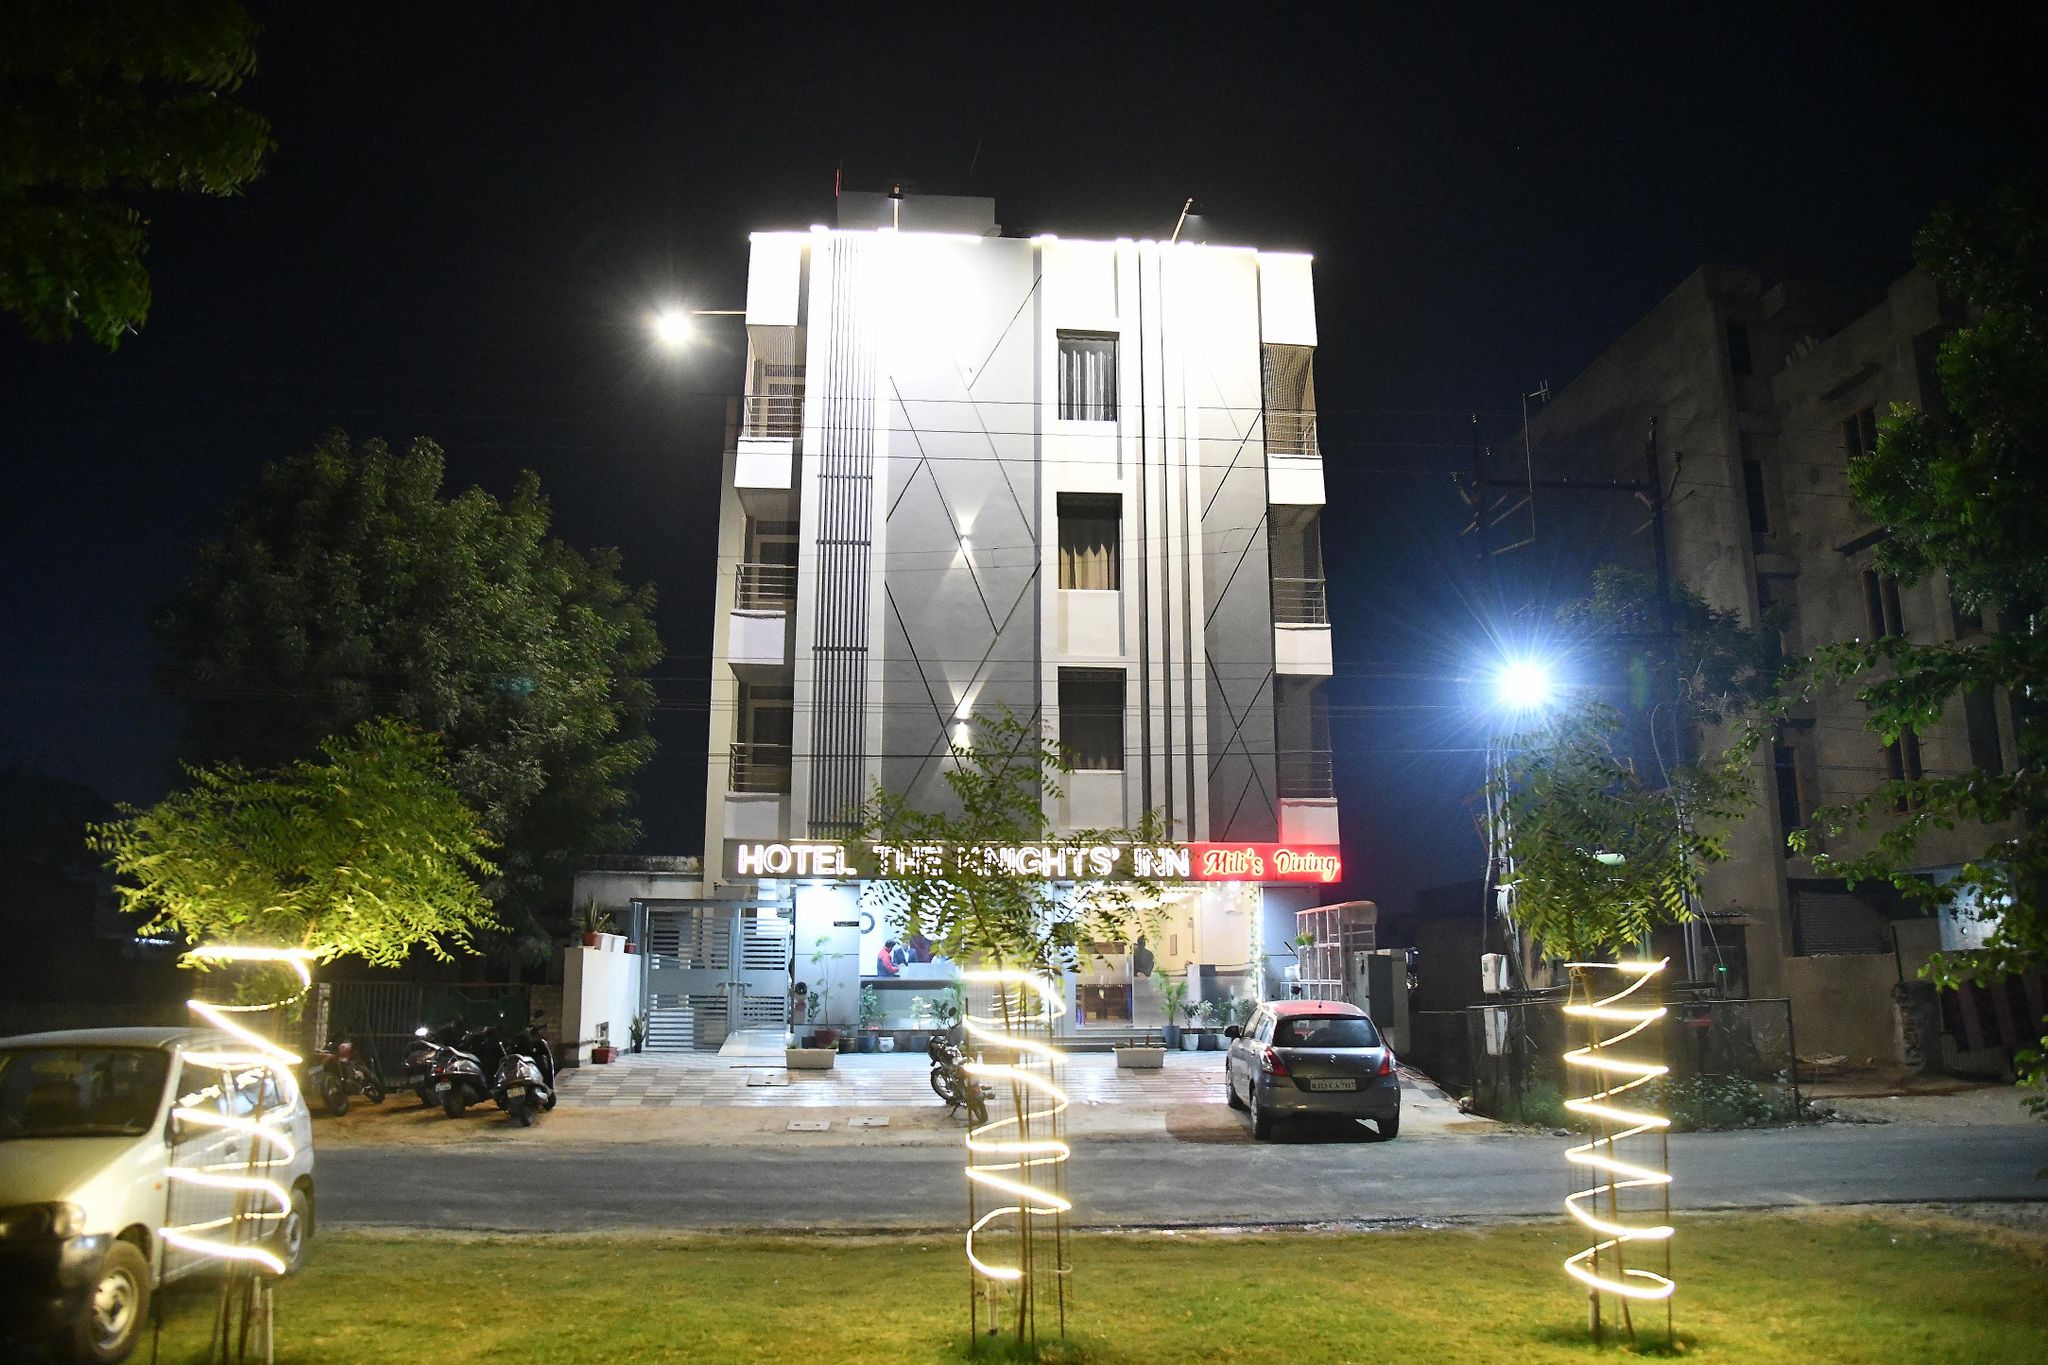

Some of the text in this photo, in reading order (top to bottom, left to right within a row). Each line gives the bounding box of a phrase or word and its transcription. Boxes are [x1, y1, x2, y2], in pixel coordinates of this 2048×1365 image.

[737, 843, 857, 876] HOTEL
[872, 845, 943, 876] THE
[1133, 847, 1190, 877] INN
[1204, 848, 1340, 881] Mili's Dining
